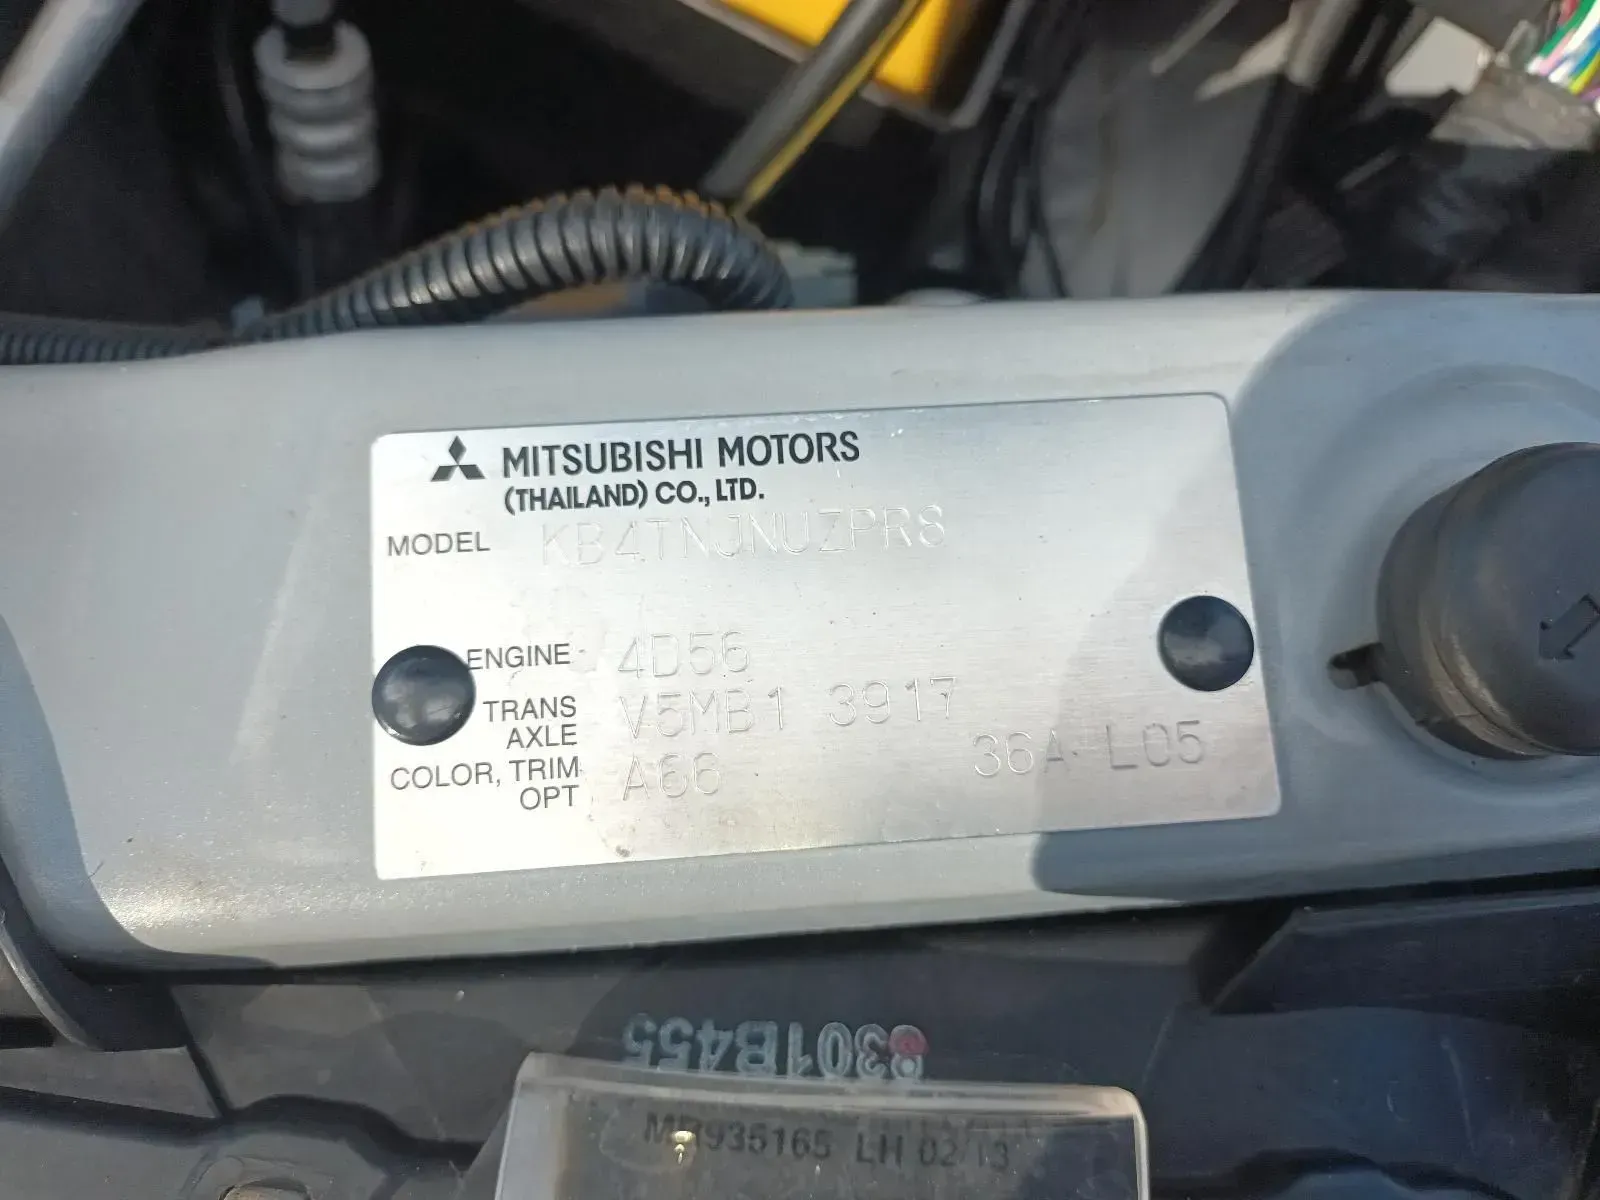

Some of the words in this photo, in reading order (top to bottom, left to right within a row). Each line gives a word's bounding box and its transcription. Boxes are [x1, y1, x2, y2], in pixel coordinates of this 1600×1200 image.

[502, 439, 703, 478] MITSUBISHI
[718, 431, 861, 467] MOTORS
[504, 483, 648, 515] (THAILAND)
[655, 480, 711, 506] CO.,
[716, 477, 765, 502] LTD.
[387, 531, 491, 557] MODEL
[467, 643, 571, 671] ENGINE
[617, 630, 750, 678] 4D56
[483, 695, 577, 723] TRANS
[828, 675, 957, 727] 3917
[506, 723, 578, 750] AXLE
[390, 761, 502, 791] COLOR,
[508, 755, 579, 783] TRIM
[621, 752, 723, 801] A66
[519, 785, 580, 811] OPT
[856, 1137, 902, 1164] LH
